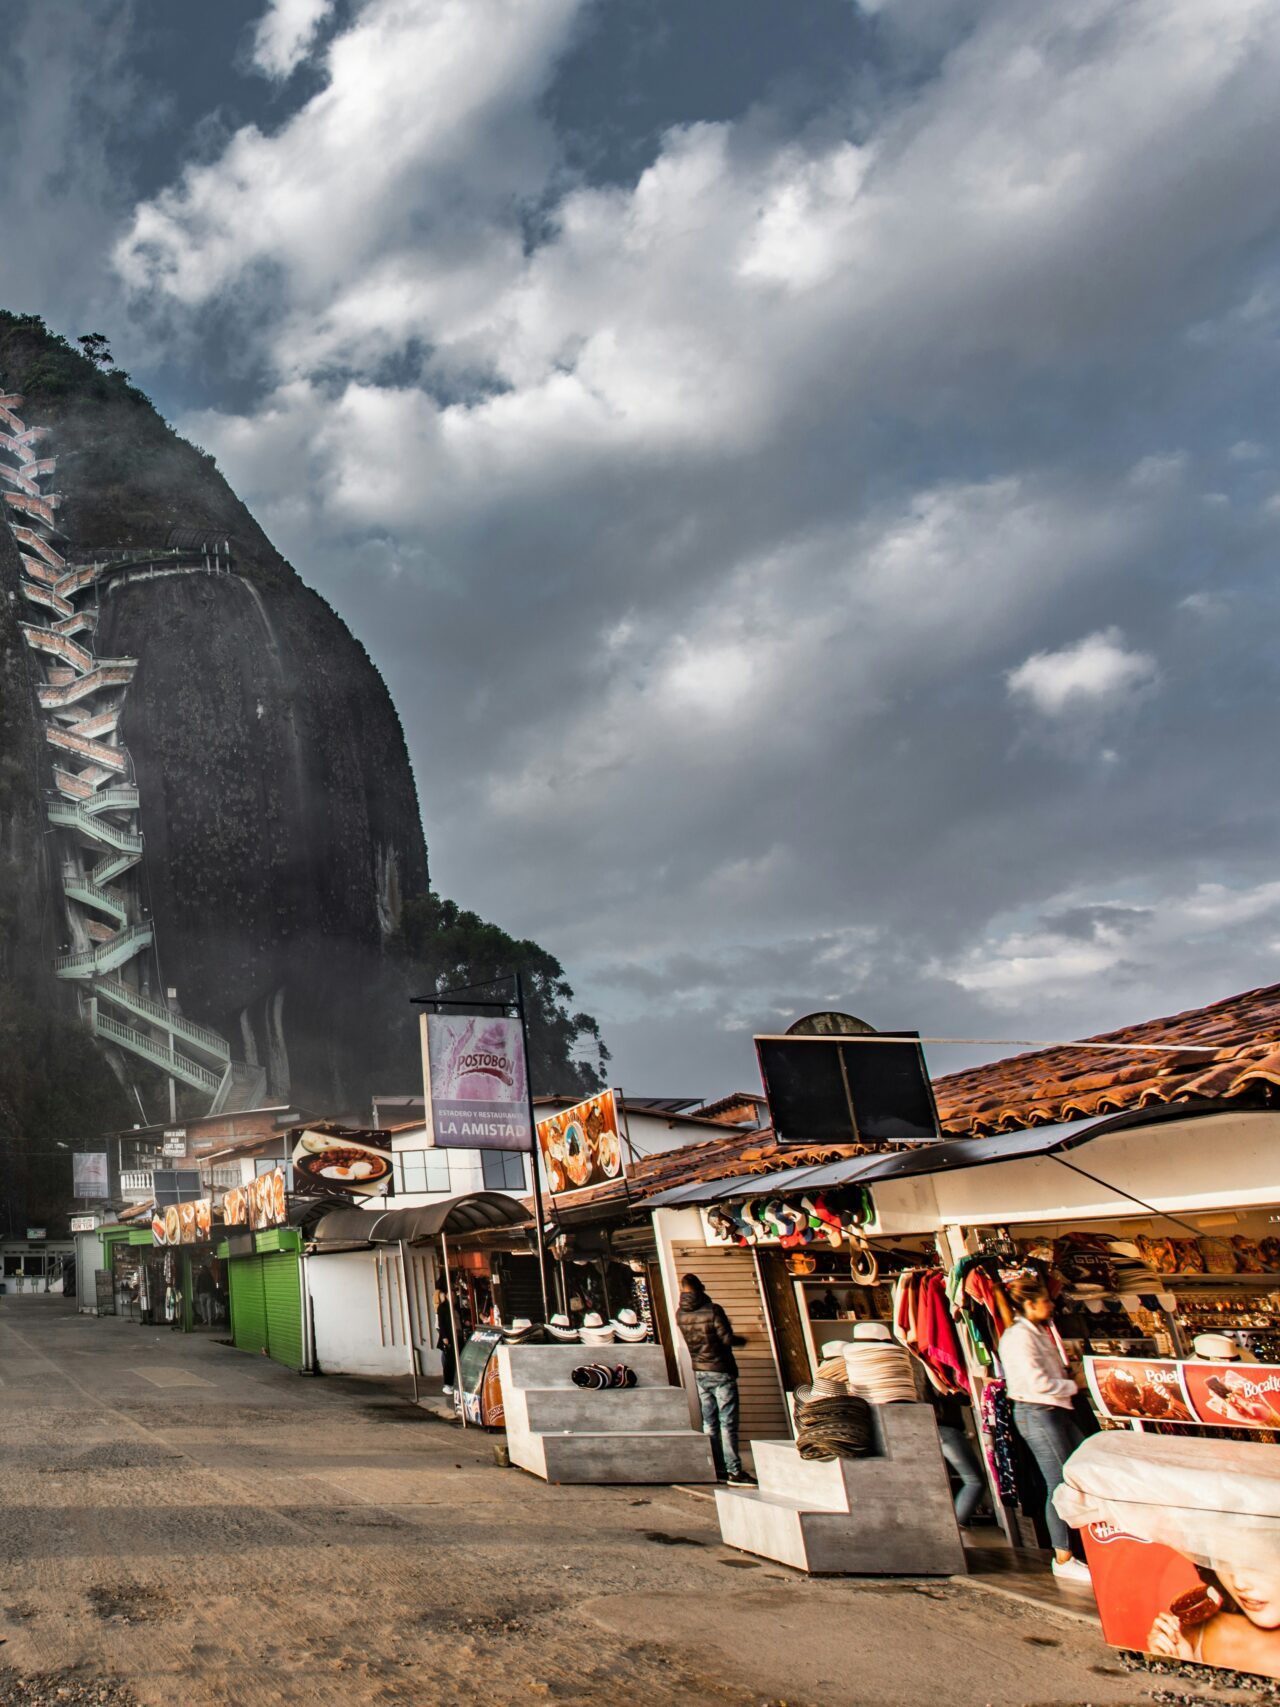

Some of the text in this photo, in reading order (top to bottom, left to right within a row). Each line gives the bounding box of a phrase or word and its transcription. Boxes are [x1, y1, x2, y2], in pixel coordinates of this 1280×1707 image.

[439, 1110, 472, 1118] ESTADERO
[440, 1122, 526, 1137] LA AMISTAD
